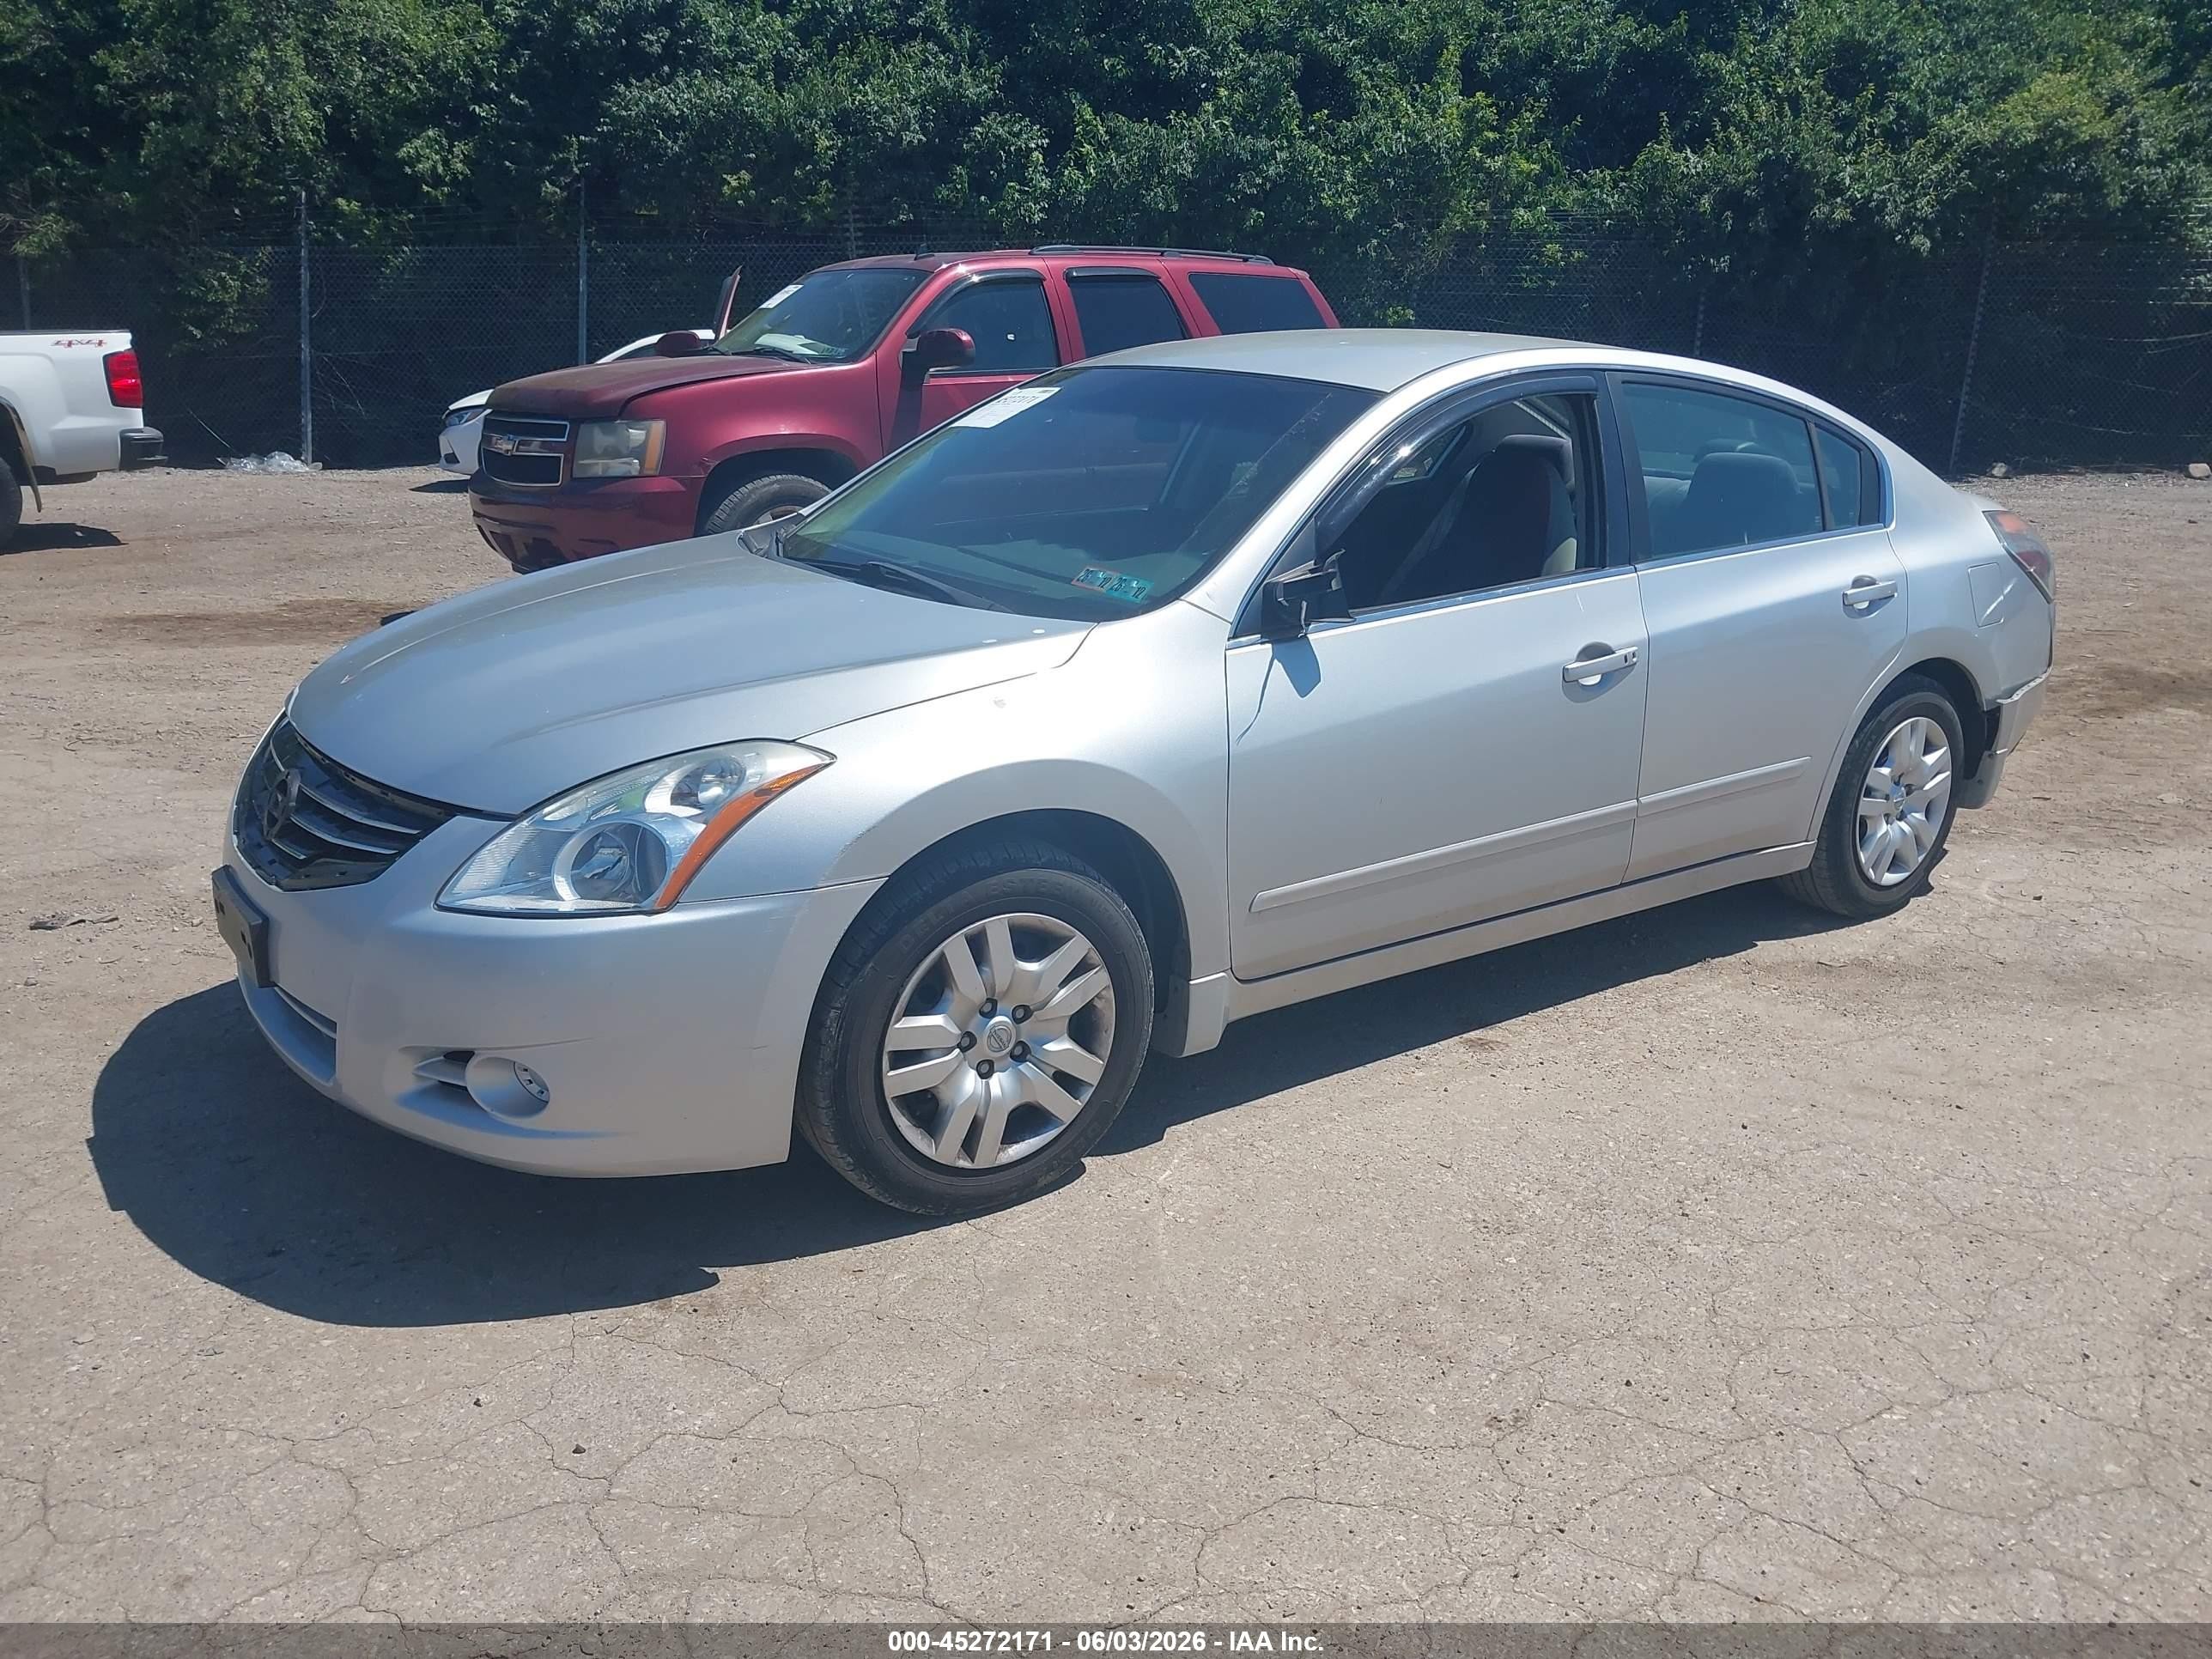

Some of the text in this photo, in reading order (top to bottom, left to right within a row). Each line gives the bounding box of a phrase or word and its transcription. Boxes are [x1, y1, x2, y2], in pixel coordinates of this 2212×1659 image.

[1098, 576, 1112, 588] 12
[1112, 577, 1146, 599] 26 12
